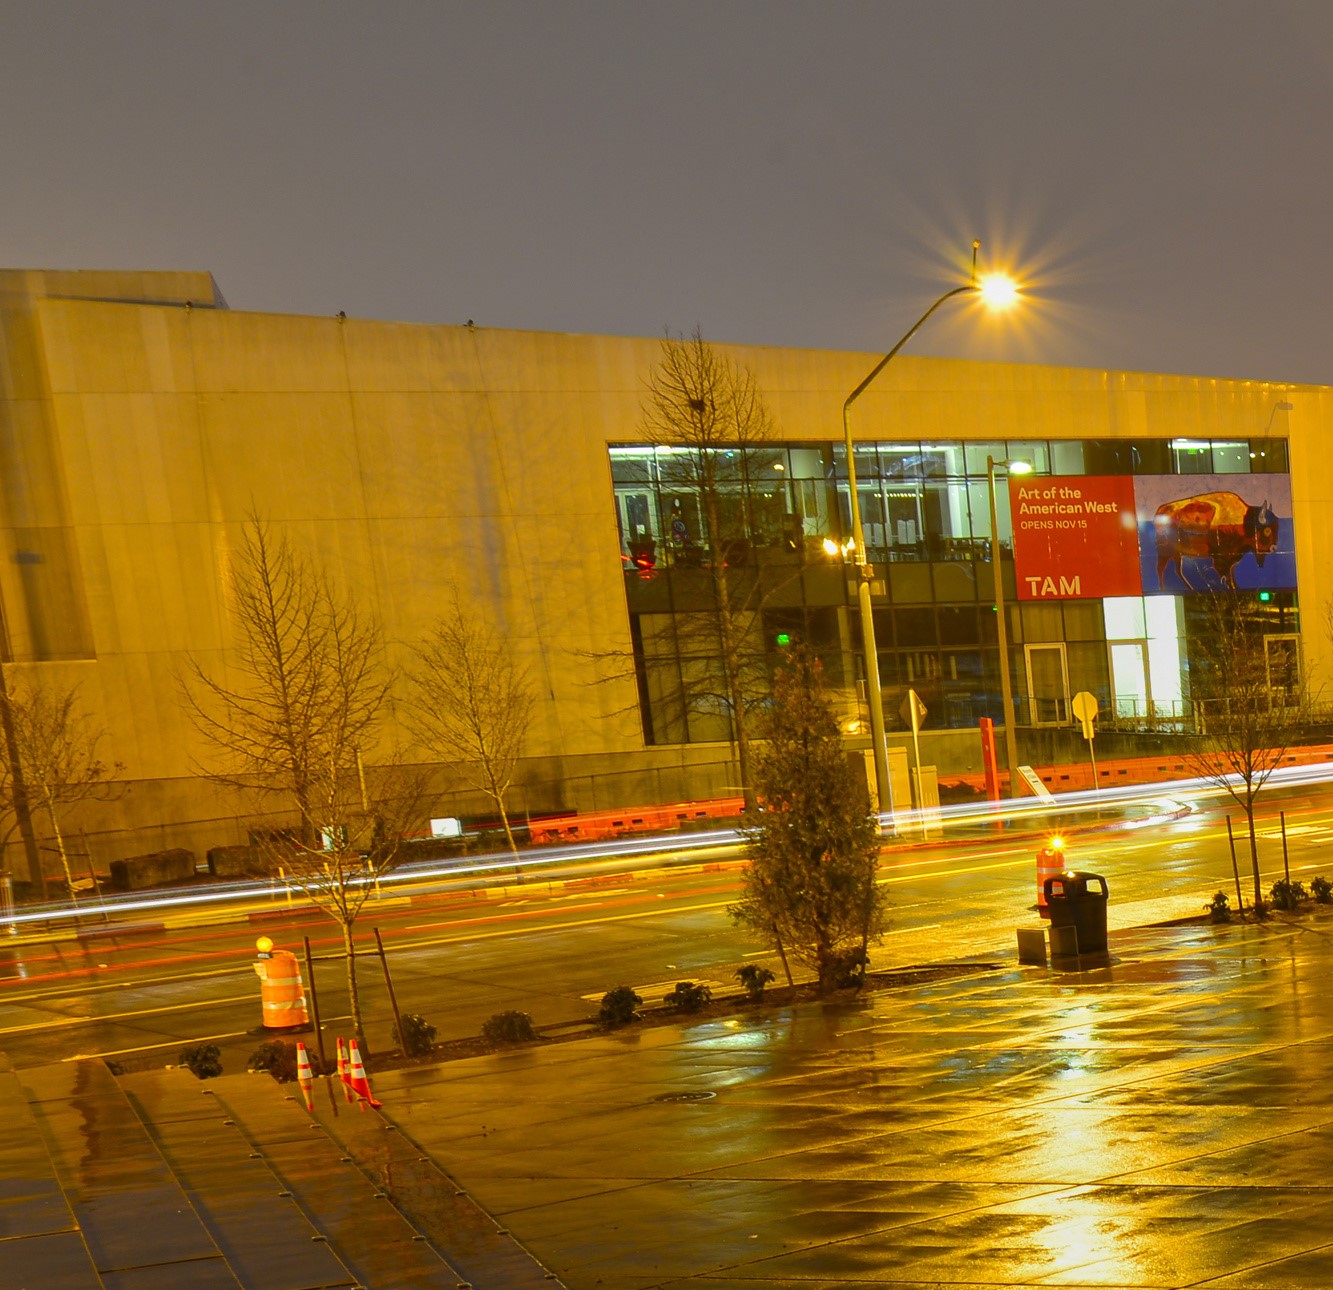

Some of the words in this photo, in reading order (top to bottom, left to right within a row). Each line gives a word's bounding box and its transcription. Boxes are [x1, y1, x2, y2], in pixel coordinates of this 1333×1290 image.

[1018, 487, 1041, 500] Art
[1043, 486, 1057, 499] of
[1059, 486, 1082, 499] the
[1020, 502, 1083, 514] American
[1084, 501, 1118, 514] West
[1020, 520, 1054, 530] OPENS
[1055, 519, 1076, 529] NOV
[1077, 519, 1088, 529] 15
[1025, 575, 1081, 597] TAM
